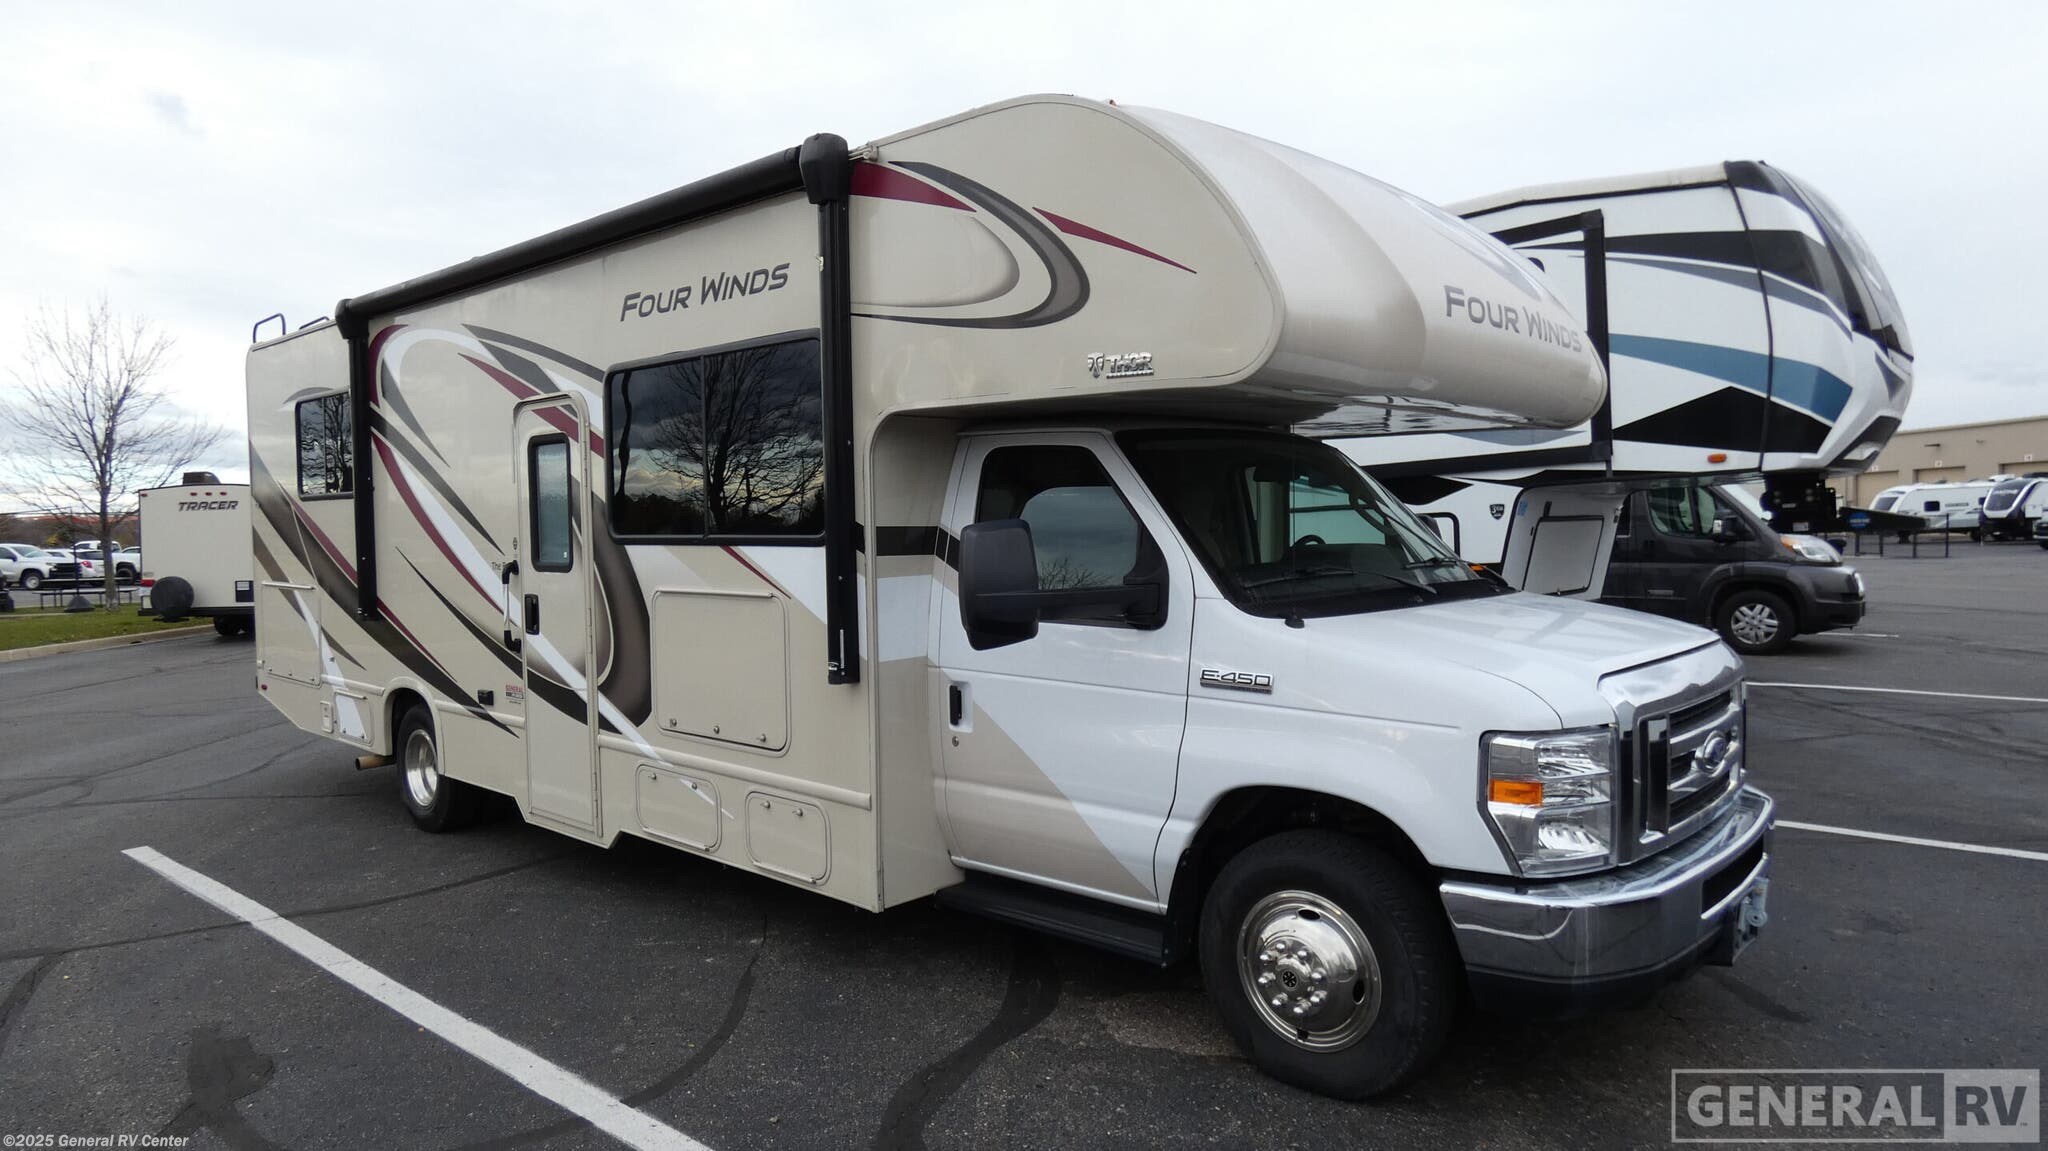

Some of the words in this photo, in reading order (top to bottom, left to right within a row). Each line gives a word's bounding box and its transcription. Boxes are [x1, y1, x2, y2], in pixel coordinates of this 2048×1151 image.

[620, 286, 692, 322] FOUR
[701, 263, 791, 305] WINDS
[1444, 284, 1520, 333] FOUR
[1522, 305, 1582, 352] WINDS
[179, 500, 239, 511] TRACER
